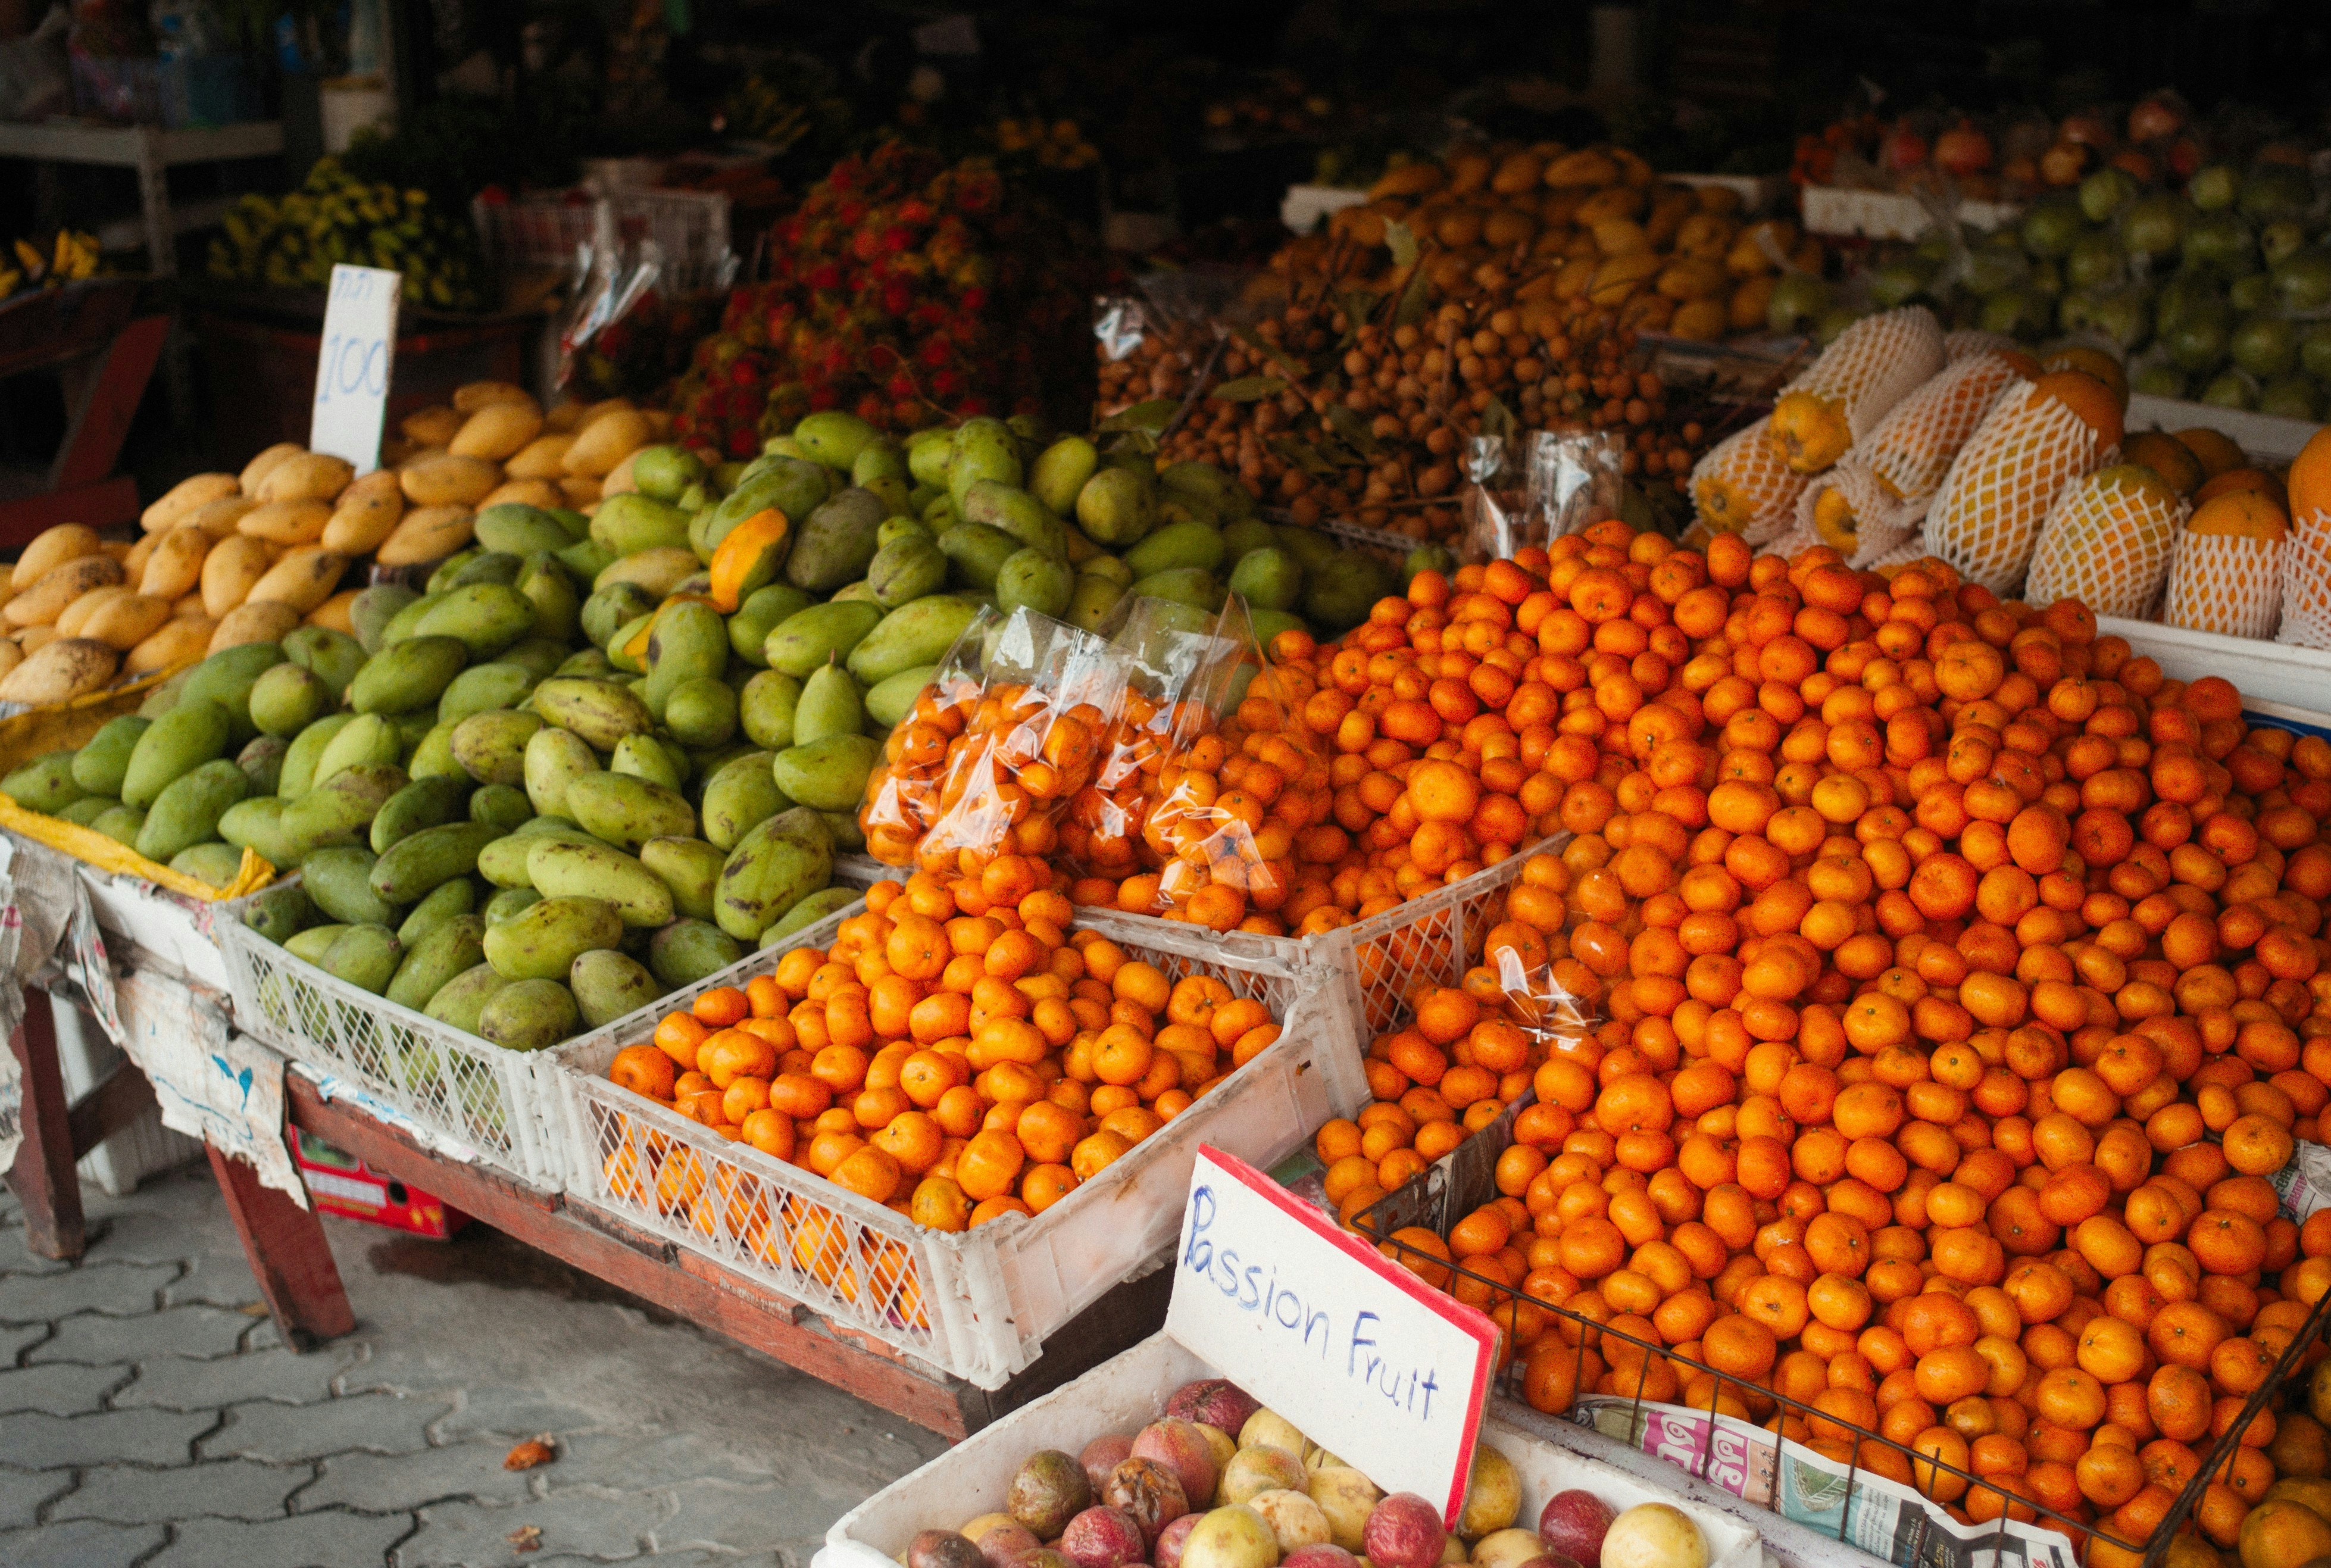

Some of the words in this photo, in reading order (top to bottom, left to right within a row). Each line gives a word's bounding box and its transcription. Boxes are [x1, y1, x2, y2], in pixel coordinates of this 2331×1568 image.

[318, 333, 388, 403] 100
[1183, 1185, 1329, 1360] Passion
[1347, 1310, 1439, 1422] Fruit
